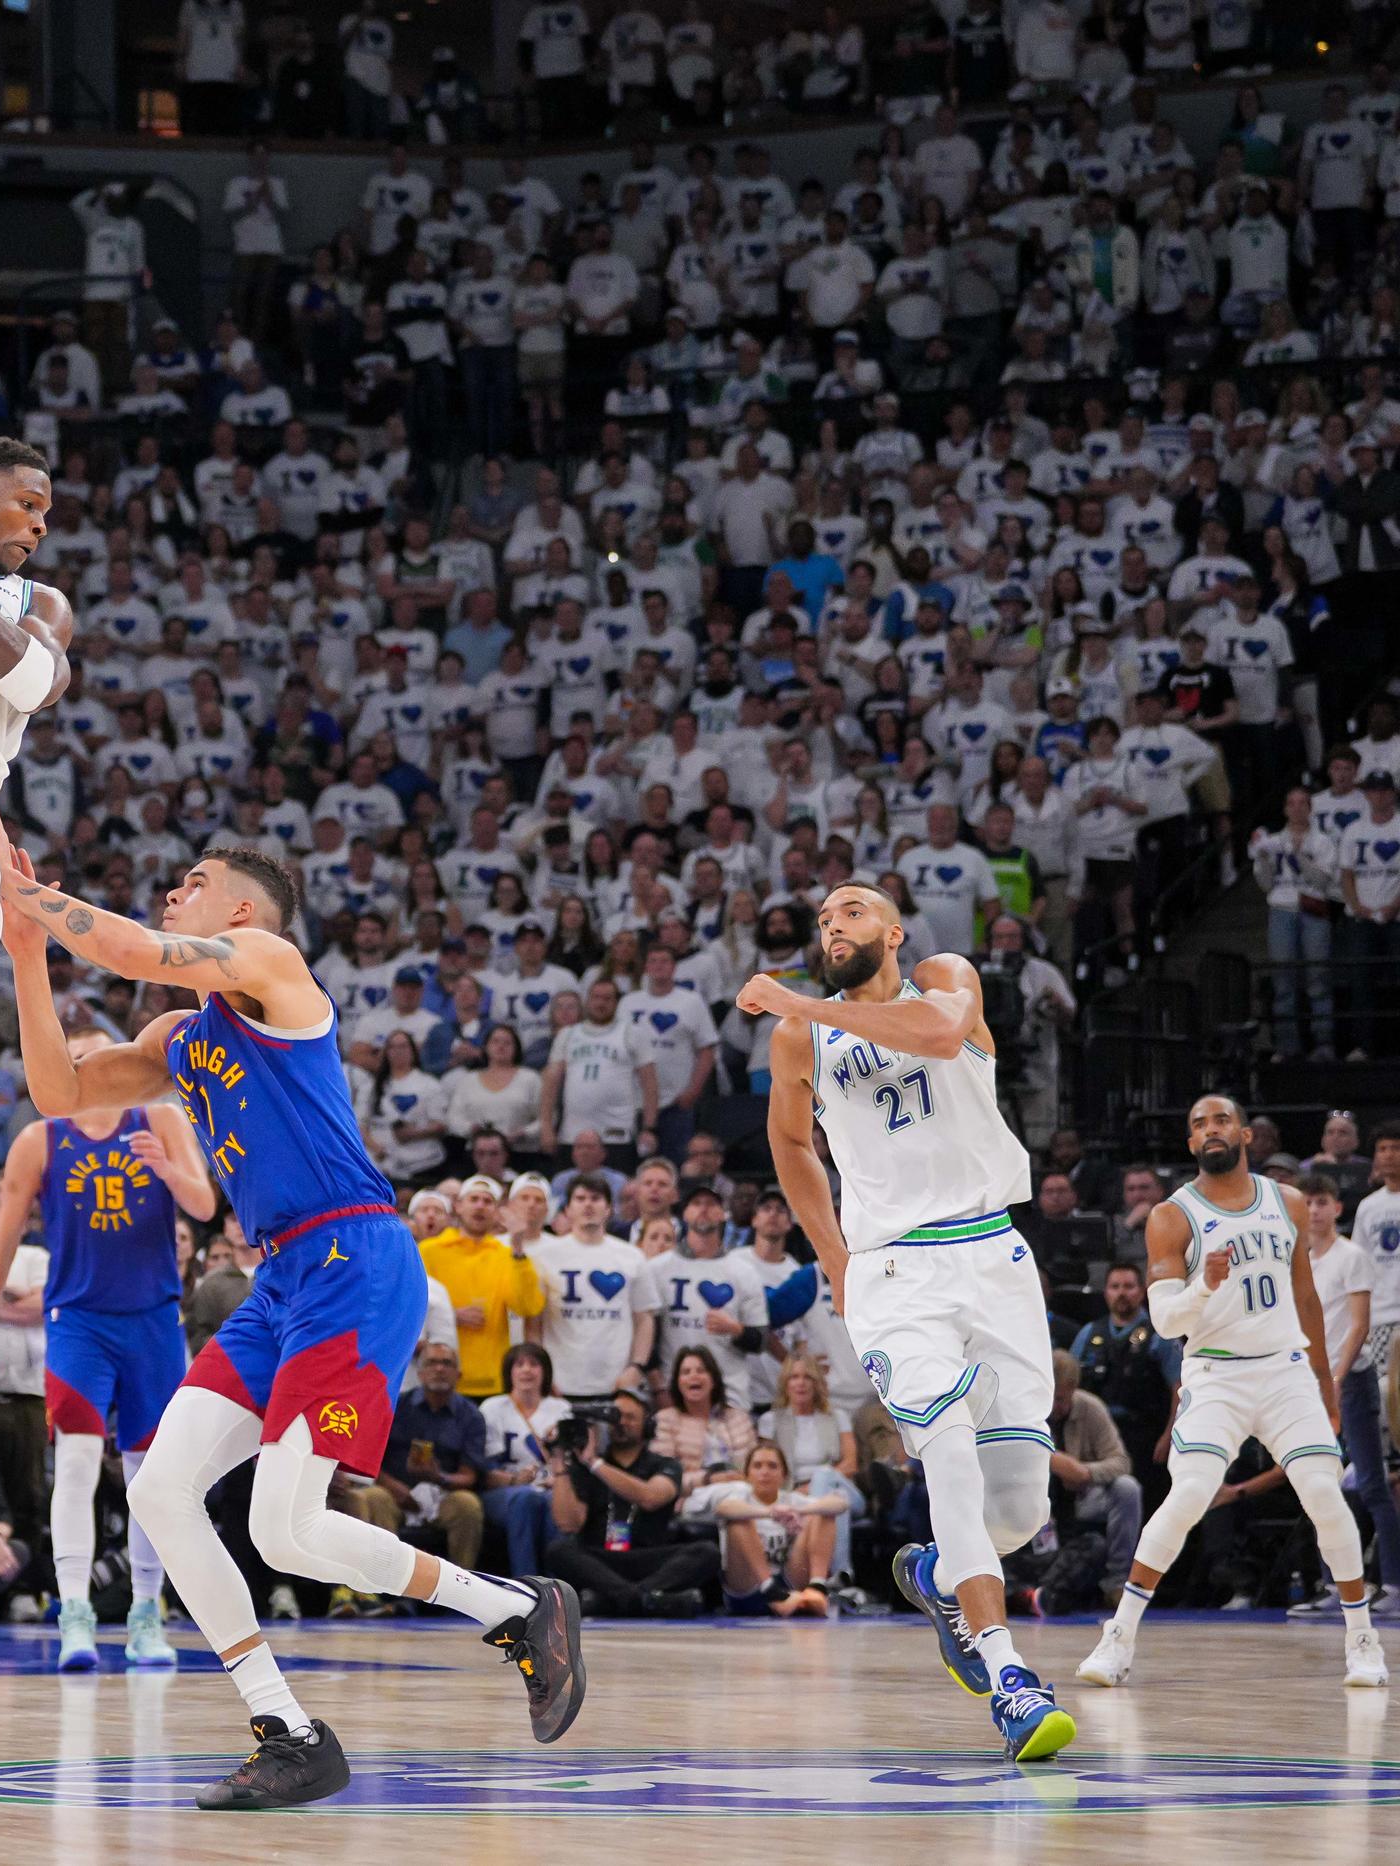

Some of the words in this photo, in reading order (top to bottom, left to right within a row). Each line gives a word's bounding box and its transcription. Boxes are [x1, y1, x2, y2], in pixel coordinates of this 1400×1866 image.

[1224, 638, 1239, 662] I
[1355, 840, 1370, 866] I
[914, 864, 931, 887] I
[504, 995, 520, 1020] I
[188, 1040, 246, 1090] HIGH
[872, 1064, 935, 1136] 27
[65, 1152, 103, 1193] MILE
[108, 1150, 151, 1189] HIGH
[93, 1175, 125, 1210] 15
[88, 1208, 134, 1232] CITY
[560, 1270, 582, 1303] I
[669, 1278, 691, 1312] I
[1240, 1272, 1280, 1314] 10
